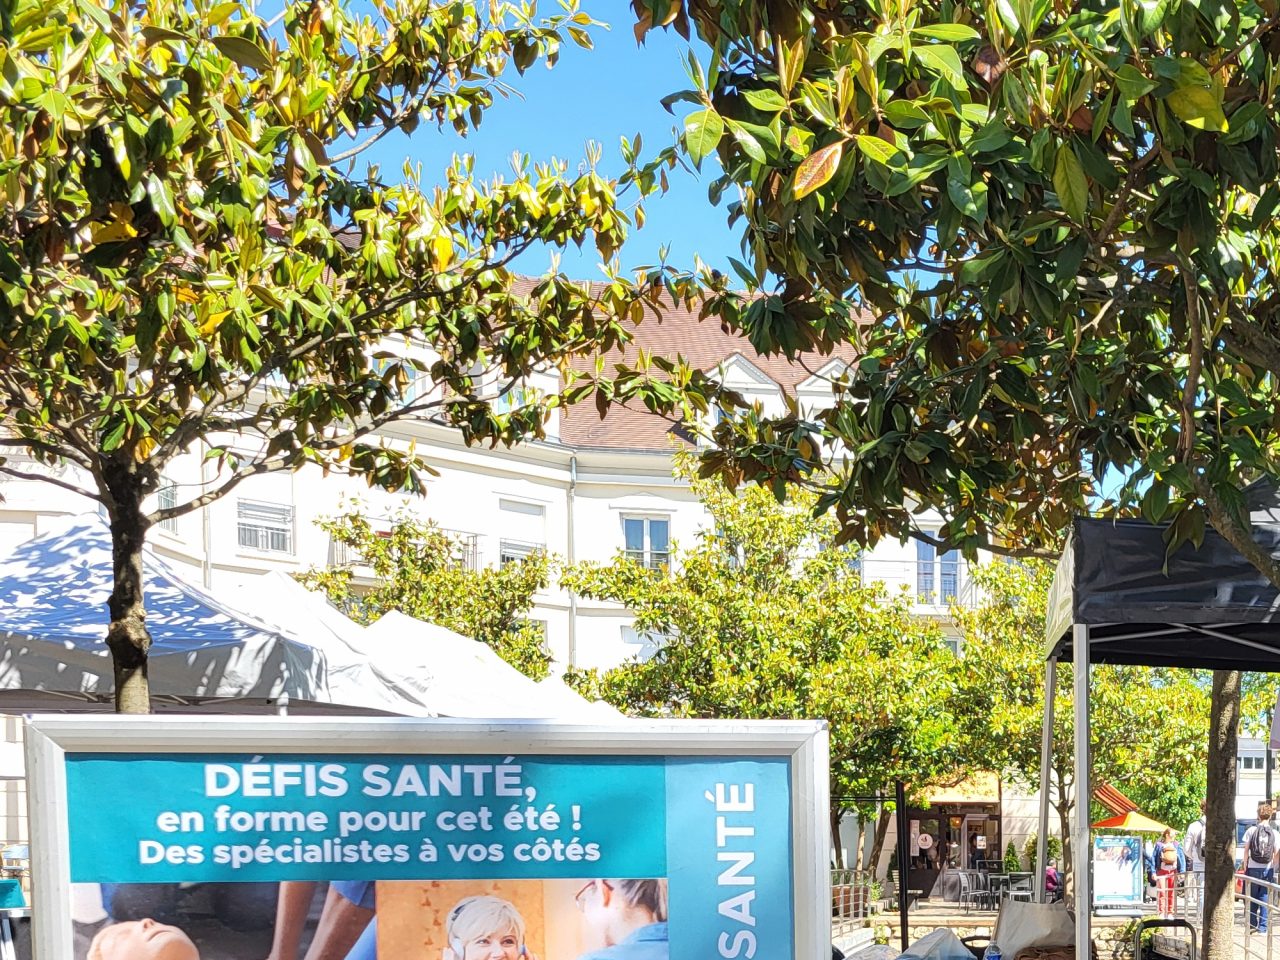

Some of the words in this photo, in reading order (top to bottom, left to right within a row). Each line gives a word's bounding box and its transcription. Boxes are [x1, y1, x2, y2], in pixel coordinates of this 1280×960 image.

[205, 755, 348, 797] DÉFIS
[362, 756, 537, 802] SANTÉ,
[156, 810, 204, 832] en
[214, 805, 328, 830] forme
[339, 810, 426, 837] pour
[436, 806, 493, 831] cet
[503, 806, 560, 831] été
[571, 804, 581, 830] !
[138, 840, 205, 864] Des
[212, 838, 410, 869] spécialistes
[418, 837, 437, 862] à
[446, 843, 504, 862] vos
[513, 836, 600, 861] côtés
[704, 782, 757, 960] SANTÉ
